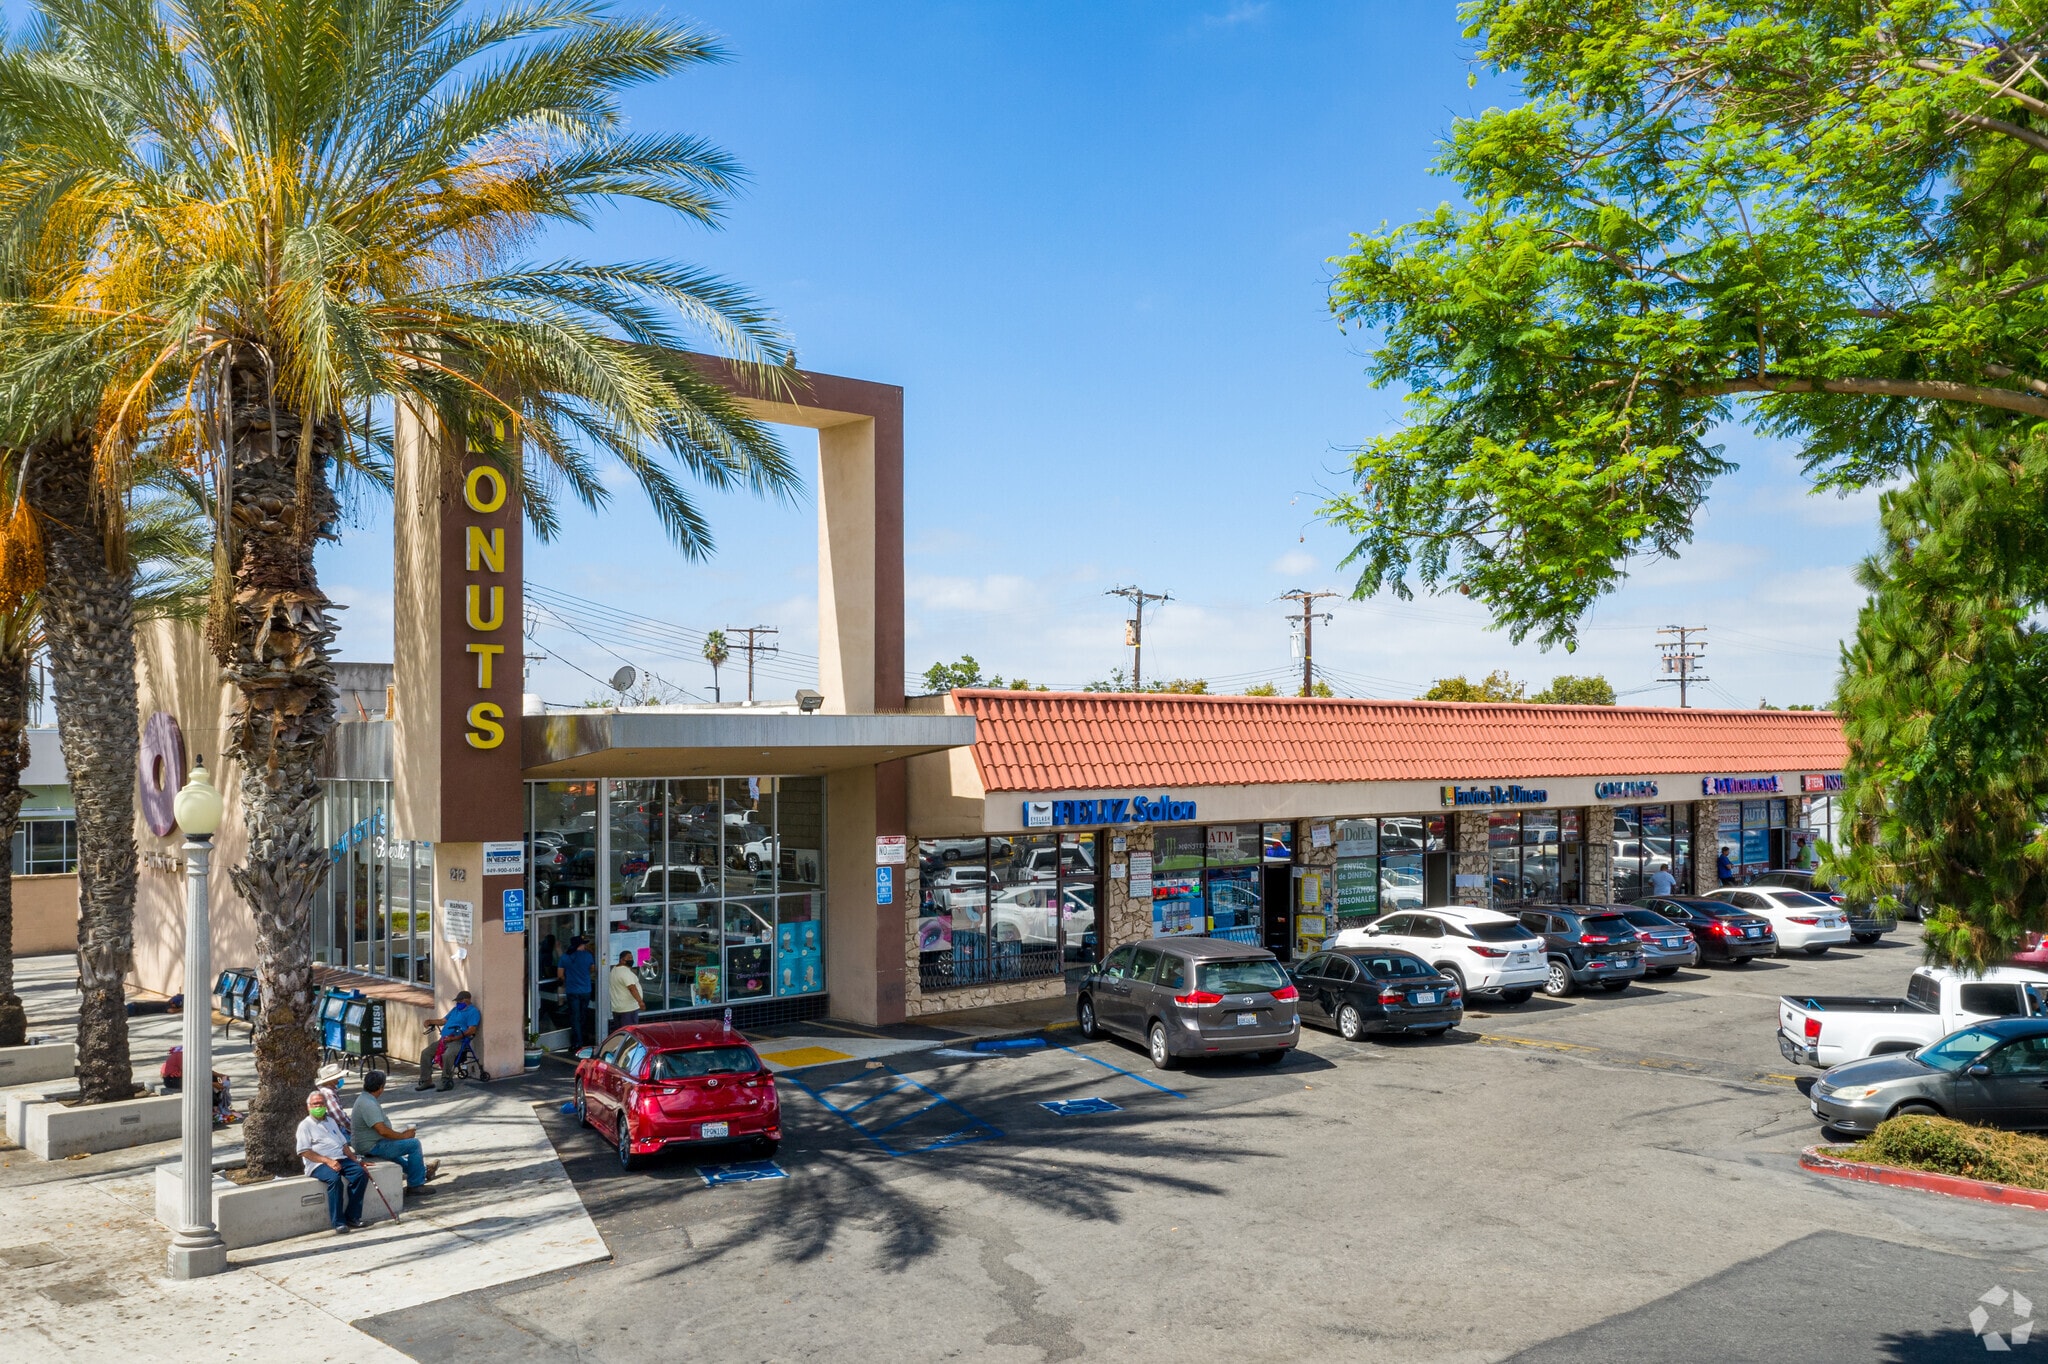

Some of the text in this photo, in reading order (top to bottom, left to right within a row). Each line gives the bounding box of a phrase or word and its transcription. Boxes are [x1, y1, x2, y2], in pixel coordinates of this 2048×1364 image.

[1595, 781, 1659, 799] CLEANERS
[1717, 779, 1728, 794] LA
[1494, 786, 1510, 804] De
[1513, 785, 1549, 804] Dinero
[1053, 795, 1197, 825] FELIZ Salon
[1744, 809, 1785, 821] AUTO TAX
[1209, 831, 1233, 843] ATM
[1345, 827, 1373, 841] DolEx
[879, 846, 887, 855] NO
[449, 868, 466, 881] 212
[621, 862, 648, 875] OPEN
[1347, 871, 1372, 879] DINERO
[372, 1005, 382, 1034] AVISO
